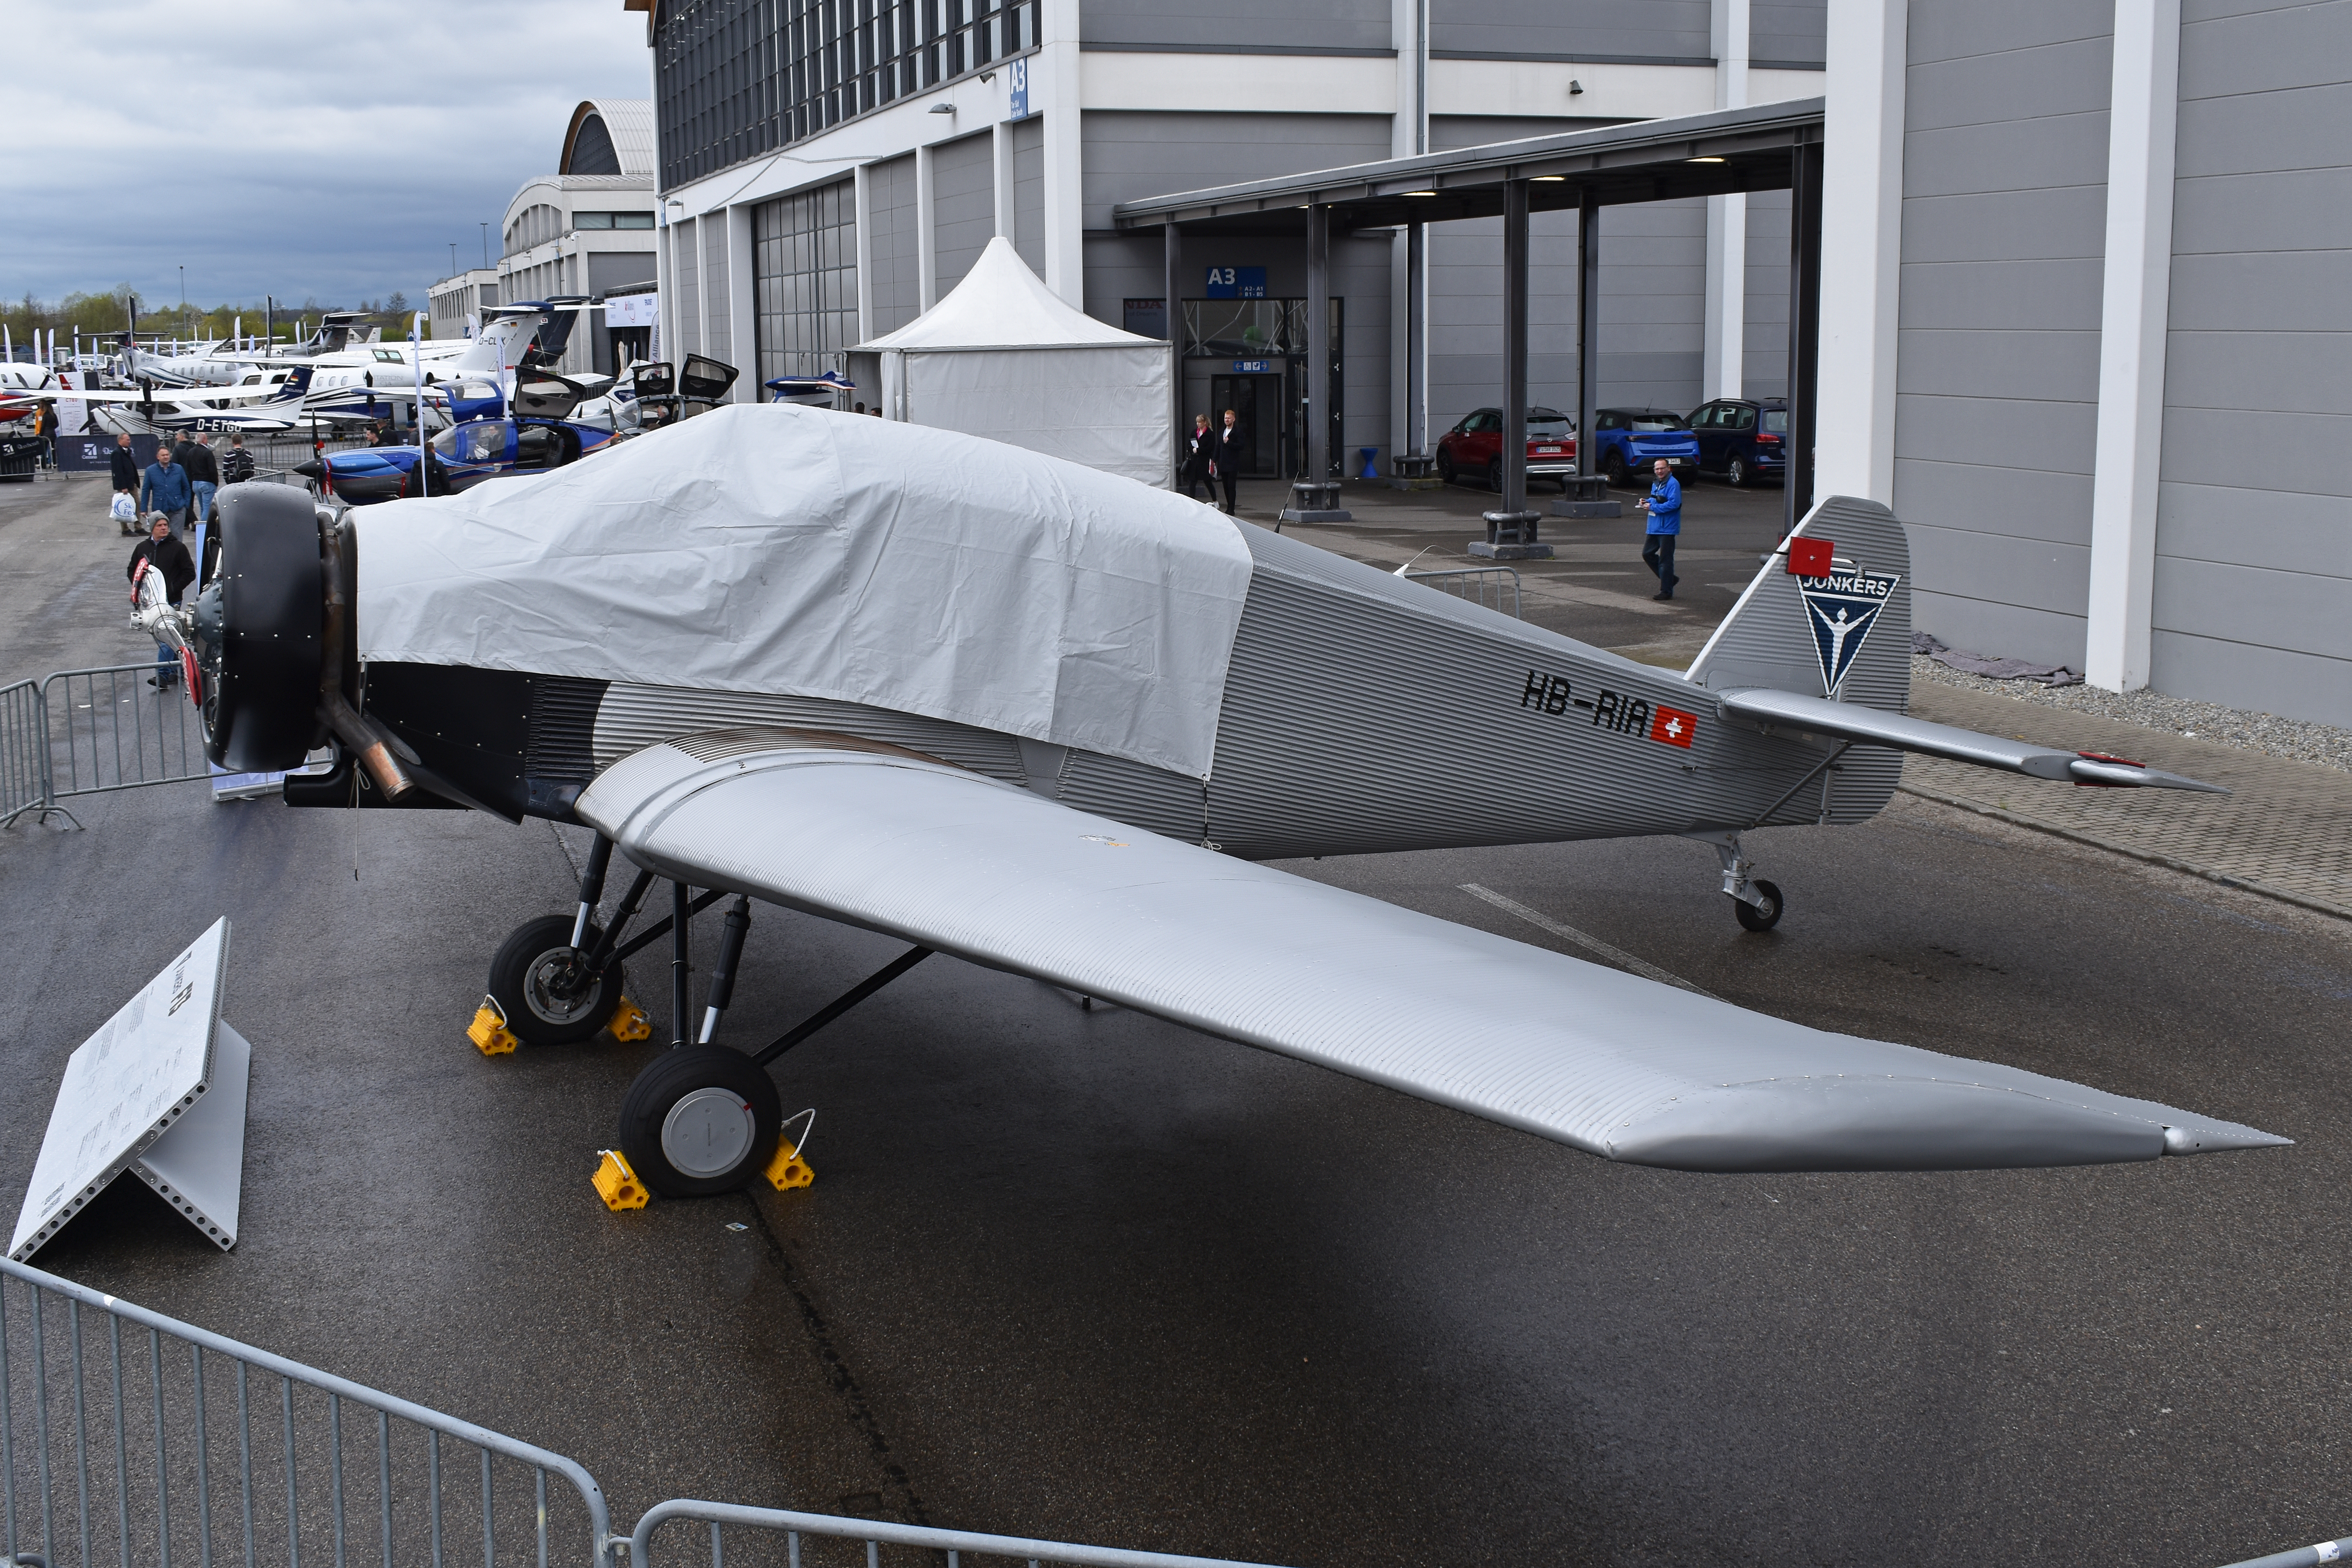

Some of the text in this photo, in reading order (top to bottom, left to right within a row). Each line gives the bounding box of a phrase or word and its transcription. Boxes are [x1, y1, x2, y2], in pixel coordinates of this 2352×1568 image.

[1011, 58, 1025, 94] A3
[1208, 268, 1235, 285] A3
[1803, 575, 1888, 596] JUNKERS
[1521, 671, 1649, 737] HB-RIA
